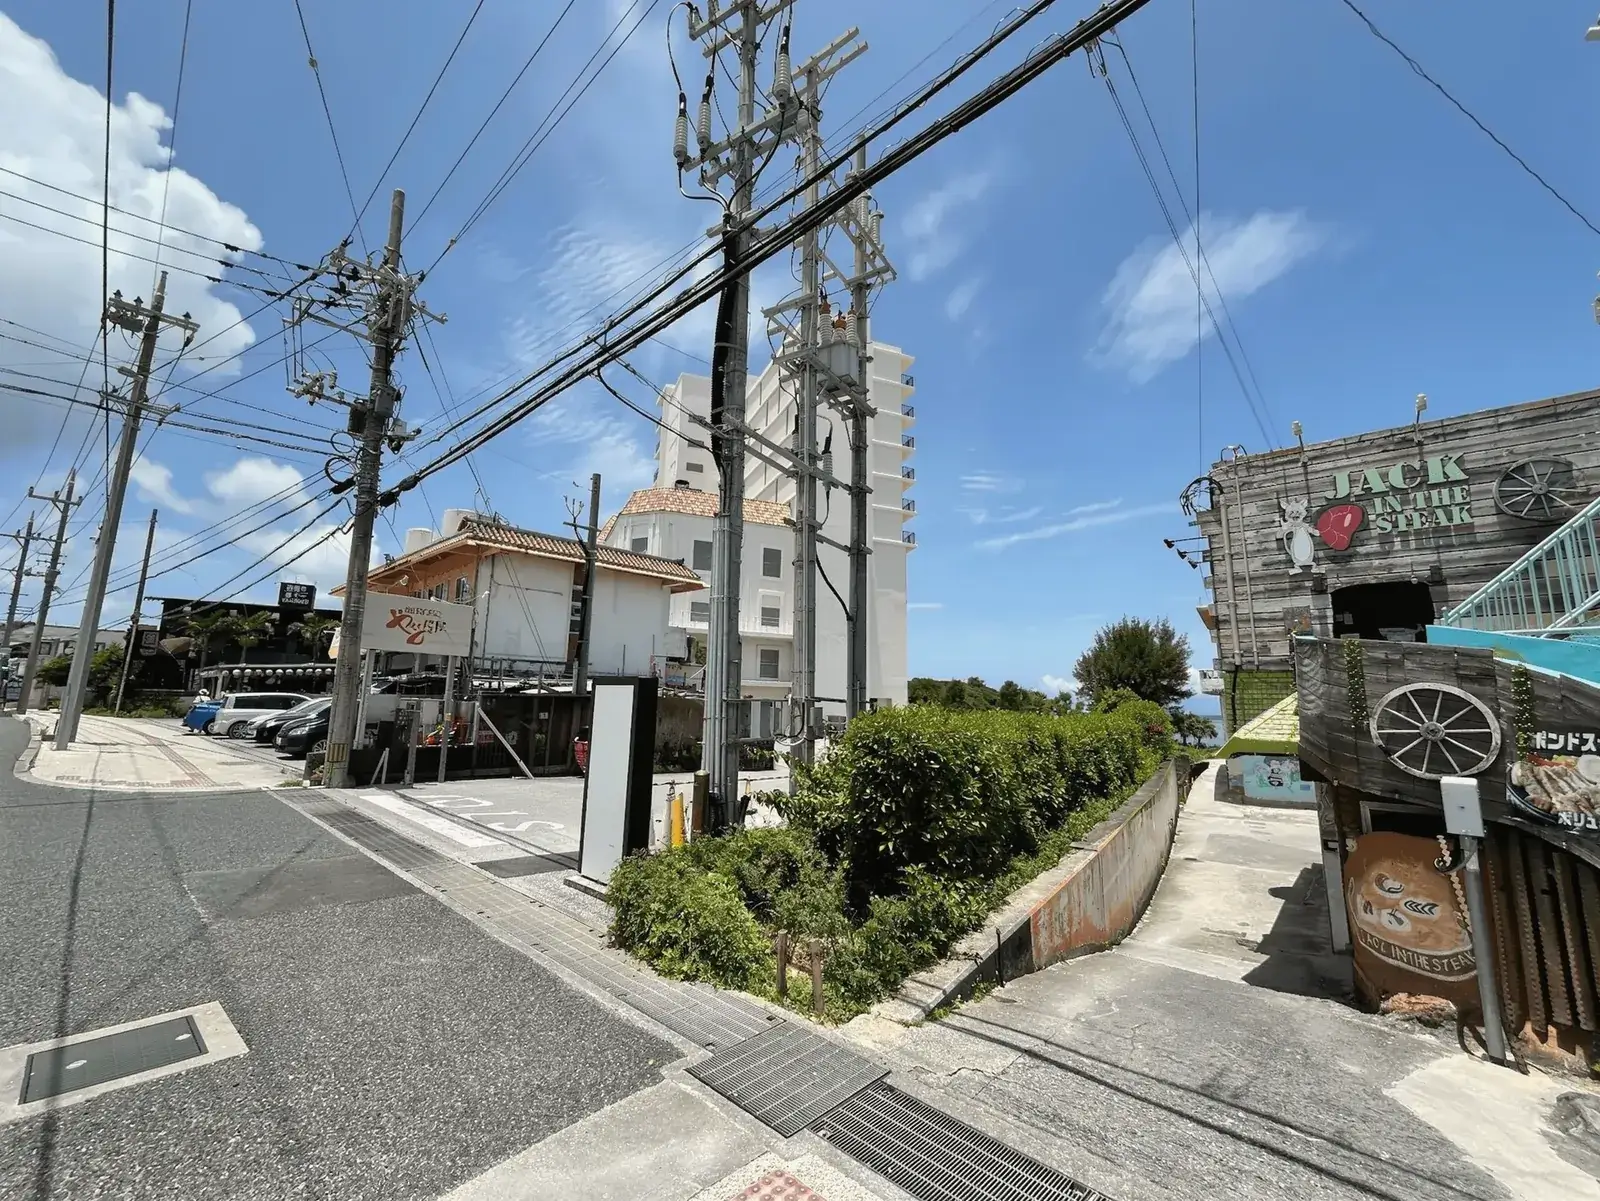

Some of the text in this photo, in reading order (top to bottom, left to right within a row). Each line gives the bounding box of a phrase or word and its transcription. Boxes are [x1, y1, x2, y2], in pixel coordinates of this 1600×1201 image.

[1324, 452, 1469, 500] JACK
[1372, 484, 1471, 516] IN THE
[1376, 505, 1474, 534] STEAK
[1532, 730, 1600, 752] ポンドス
